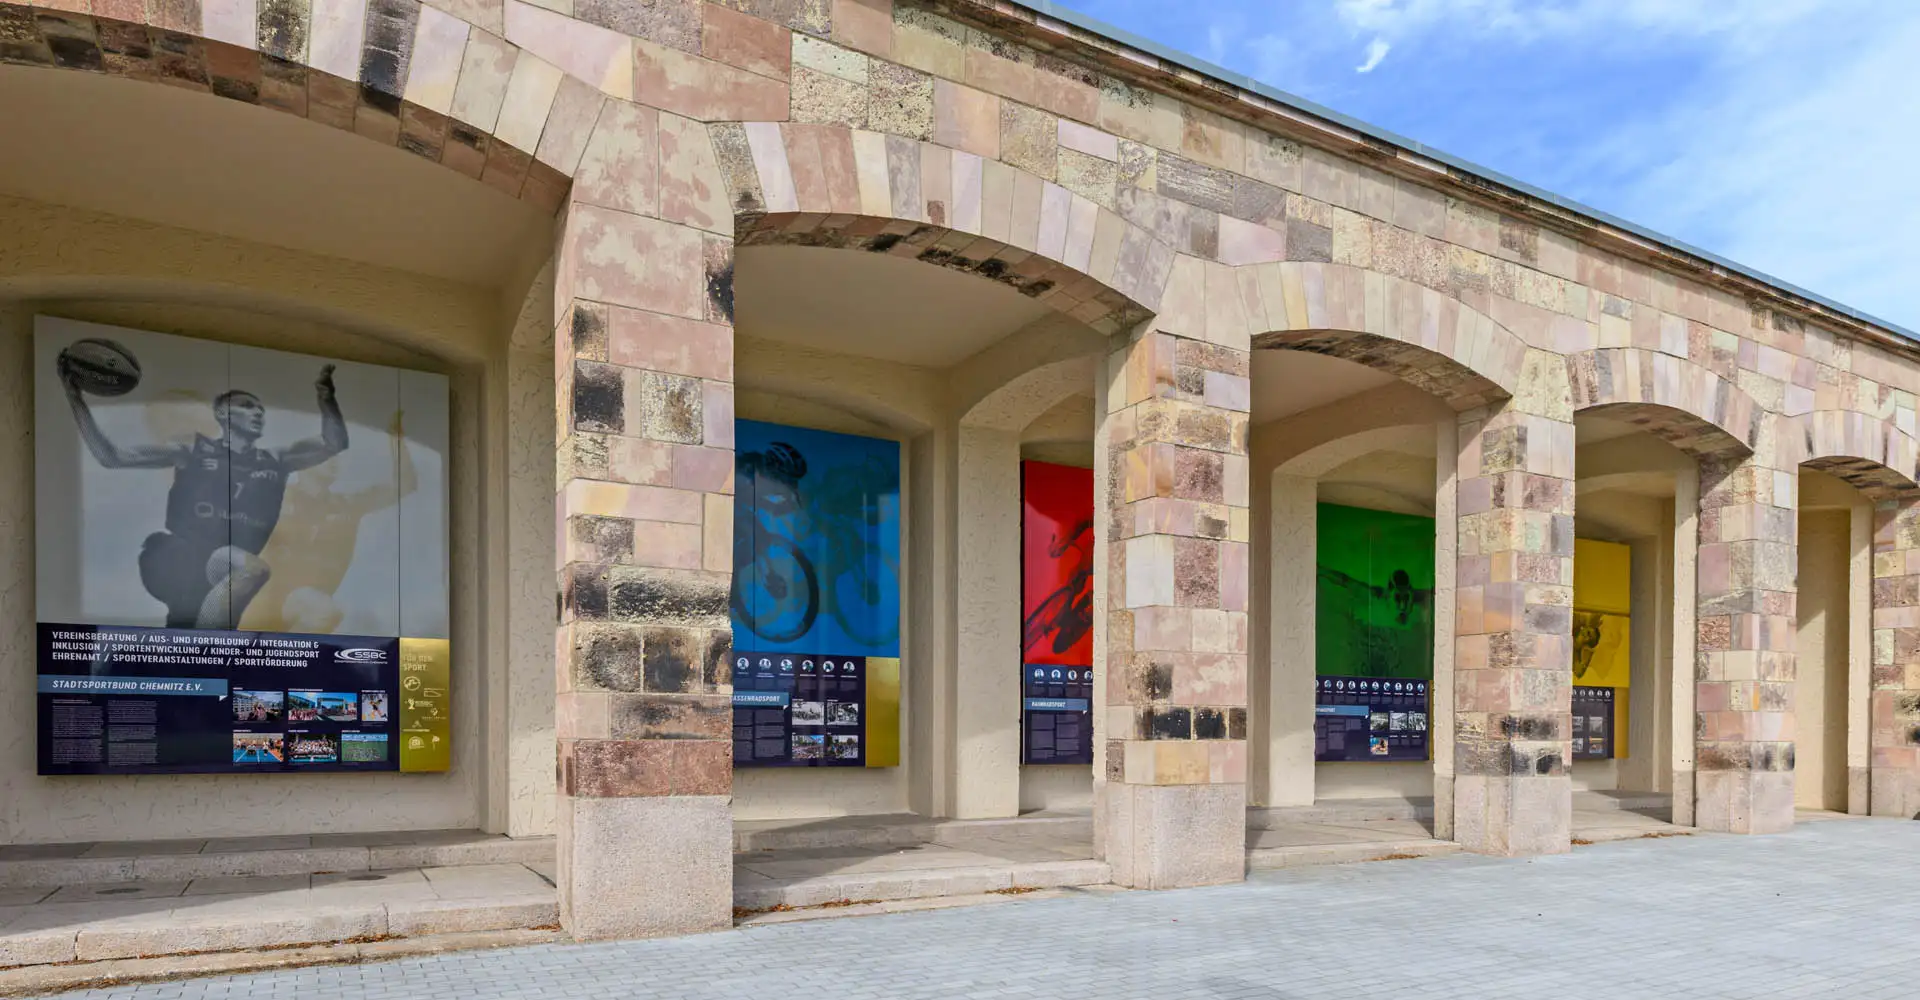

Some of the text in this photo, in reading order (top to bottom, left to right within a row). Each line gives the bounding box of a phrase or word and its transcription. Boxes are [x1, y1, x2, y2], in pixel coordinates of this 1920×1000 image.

[52, 631, 138, 642] VEREINSBERATUNG
[149, 635, 170, 643] AUS-
[172, 636, 191, 644] UND
[193, 637, 250, 646] FORTBILDUNG
[260, 639, 312, 649] INTEGRATION
[314, 641, 319, 649] &
[52, 641, 101, 651] INKLUSION
[111, 643, 200, 654] SPORTENTWICKLUNG
[210, 648, 244, 656] KINDER-
[246, 649, 263, 657] UND
[265, 650, 320, 659] JUGENDSPORT
[354, 651, 387, 659] SSBC
[52, 652, 101, 661] EHRENAMT
[113, 654, 224, 665] SPORTVERANSTALTUNGEN
[234, 657, 308, 667] SPORTFÖRDERUNG
[52, 680, 203, 691] STADTSPORTBUND CHEMNITZ E.V.
